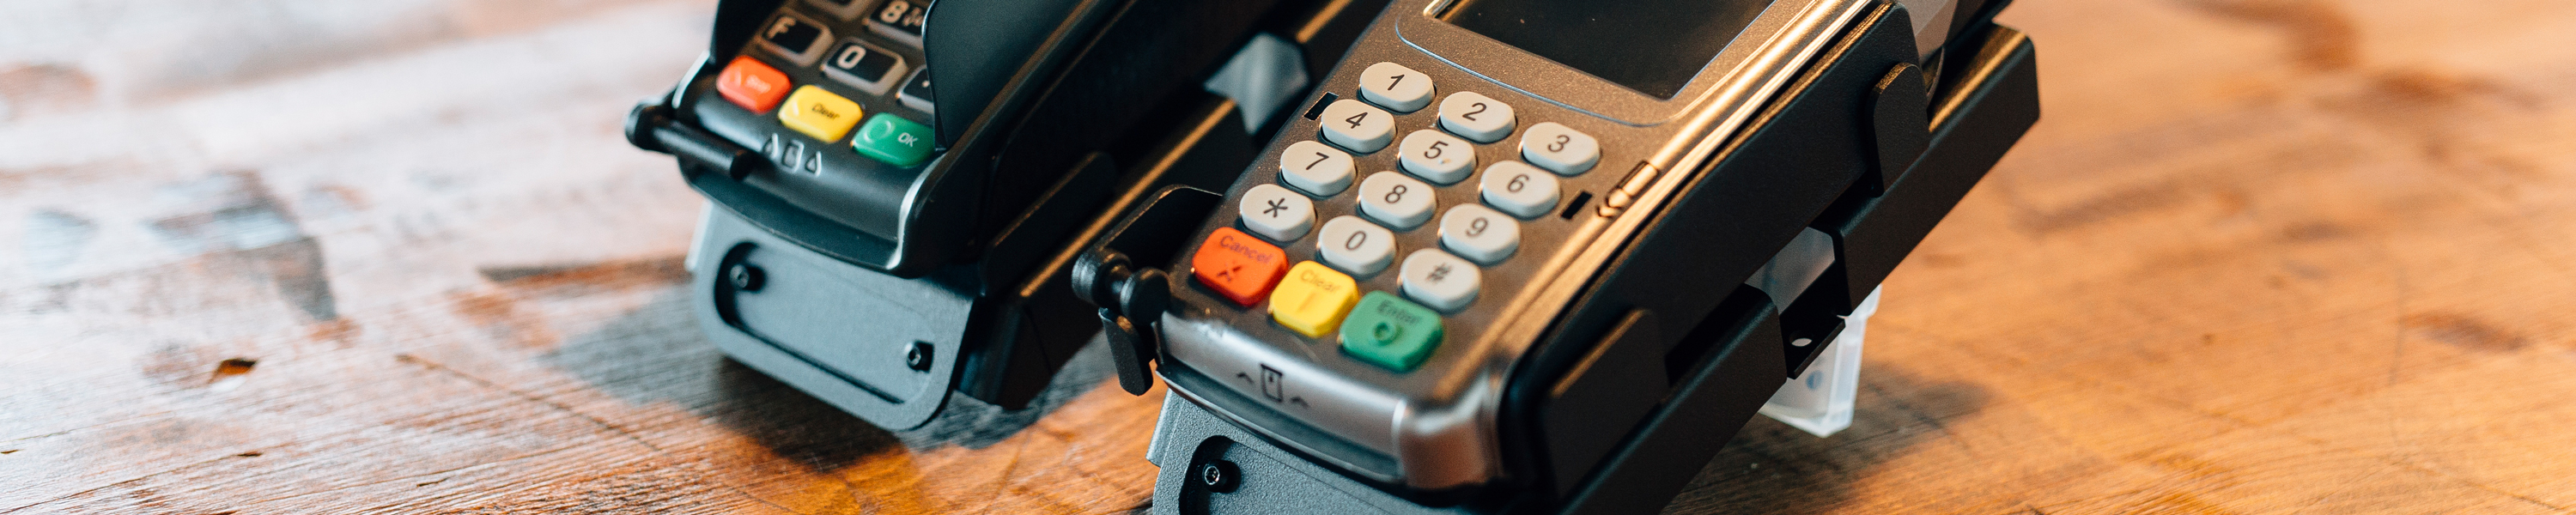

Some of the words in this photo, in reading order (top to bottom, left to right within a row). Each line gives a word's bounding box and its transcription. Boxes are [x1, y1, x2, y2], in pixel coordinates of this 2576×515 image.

[1387, 74, 1405, 91] 1
[811, 103, 840, 119] Clear
[1345, 112, 1369, 130] 4
[1461, 102, 1487, 122] 2
[897, 132, 918, 148] OK
[1424, 140, 1449, 160] 5
[1546, 134, 1571, 154] 3
[1305, 151, 1329, 171] 7
[1506, 173, 1530, 193] 6
[1384, 184, 1408, 204] 8
[1465, 216, 1489, 238] 9
[1220, 235, 1273, 264] Cancel
[1345, 230, 1367, 251] 0
[1301, 270, 1341, 293] Clear
[1426, 264, 1451, 282] #
[1377, 300, 1422, 324] Enter
